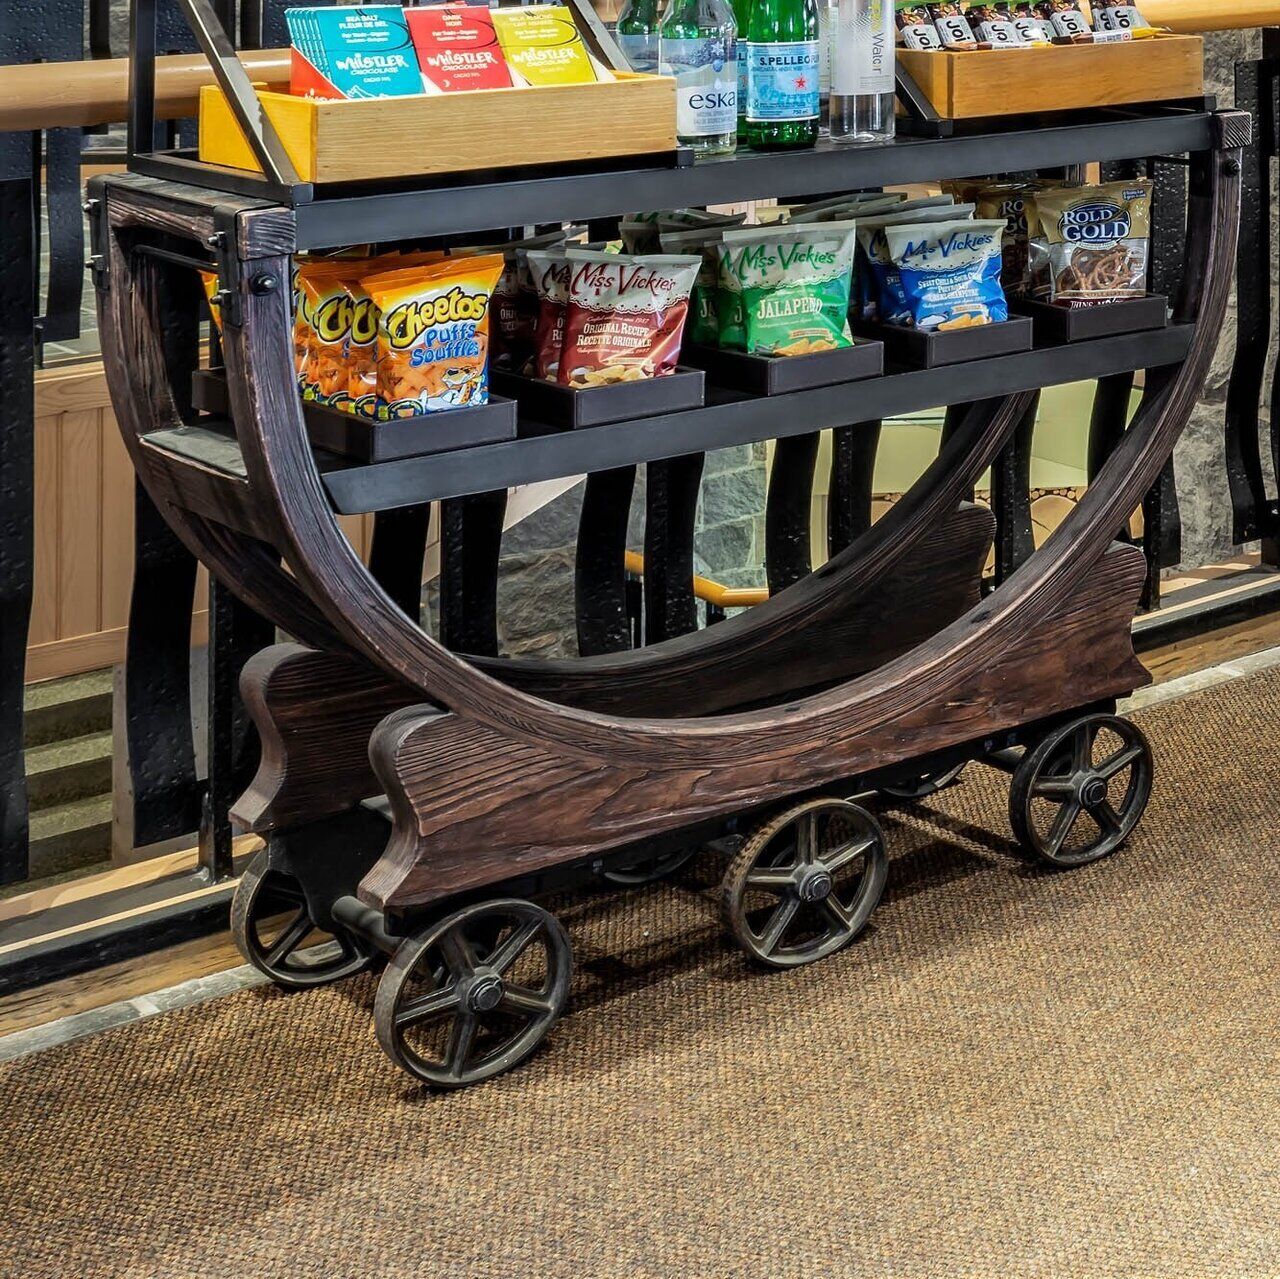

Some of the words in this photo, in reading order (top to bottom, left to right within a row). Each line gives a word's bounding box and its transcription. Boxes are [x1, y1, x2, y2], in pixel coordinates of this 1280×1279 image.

[336, 53, 409, 70] WHISTLER
[427, 50, 499, 67] WHISTLER
[512, 48, 580, 65] WHISTLER
[872, 33, 885, 74] Water
[351, 67, 399, 75] CHOCOLATE
[441, 63, 489, 72] CHOCOLATE
[689, 91, 736, 110] eska
[1062, 209, 1113, 225] ROLD
[1062, 221, 1130, 242] GOLD
[938, 232, 994, 258] Vickie's
[738, 244, 776, 280] Miss
[777, 242, 838, 270] Vickie's
[571, 262, 615, 296] Miss
[617, 264, 677, 296] Vickie's
[387, 286, 488, 348] Cheetos
[425, 323, 476, 348] Puffs
